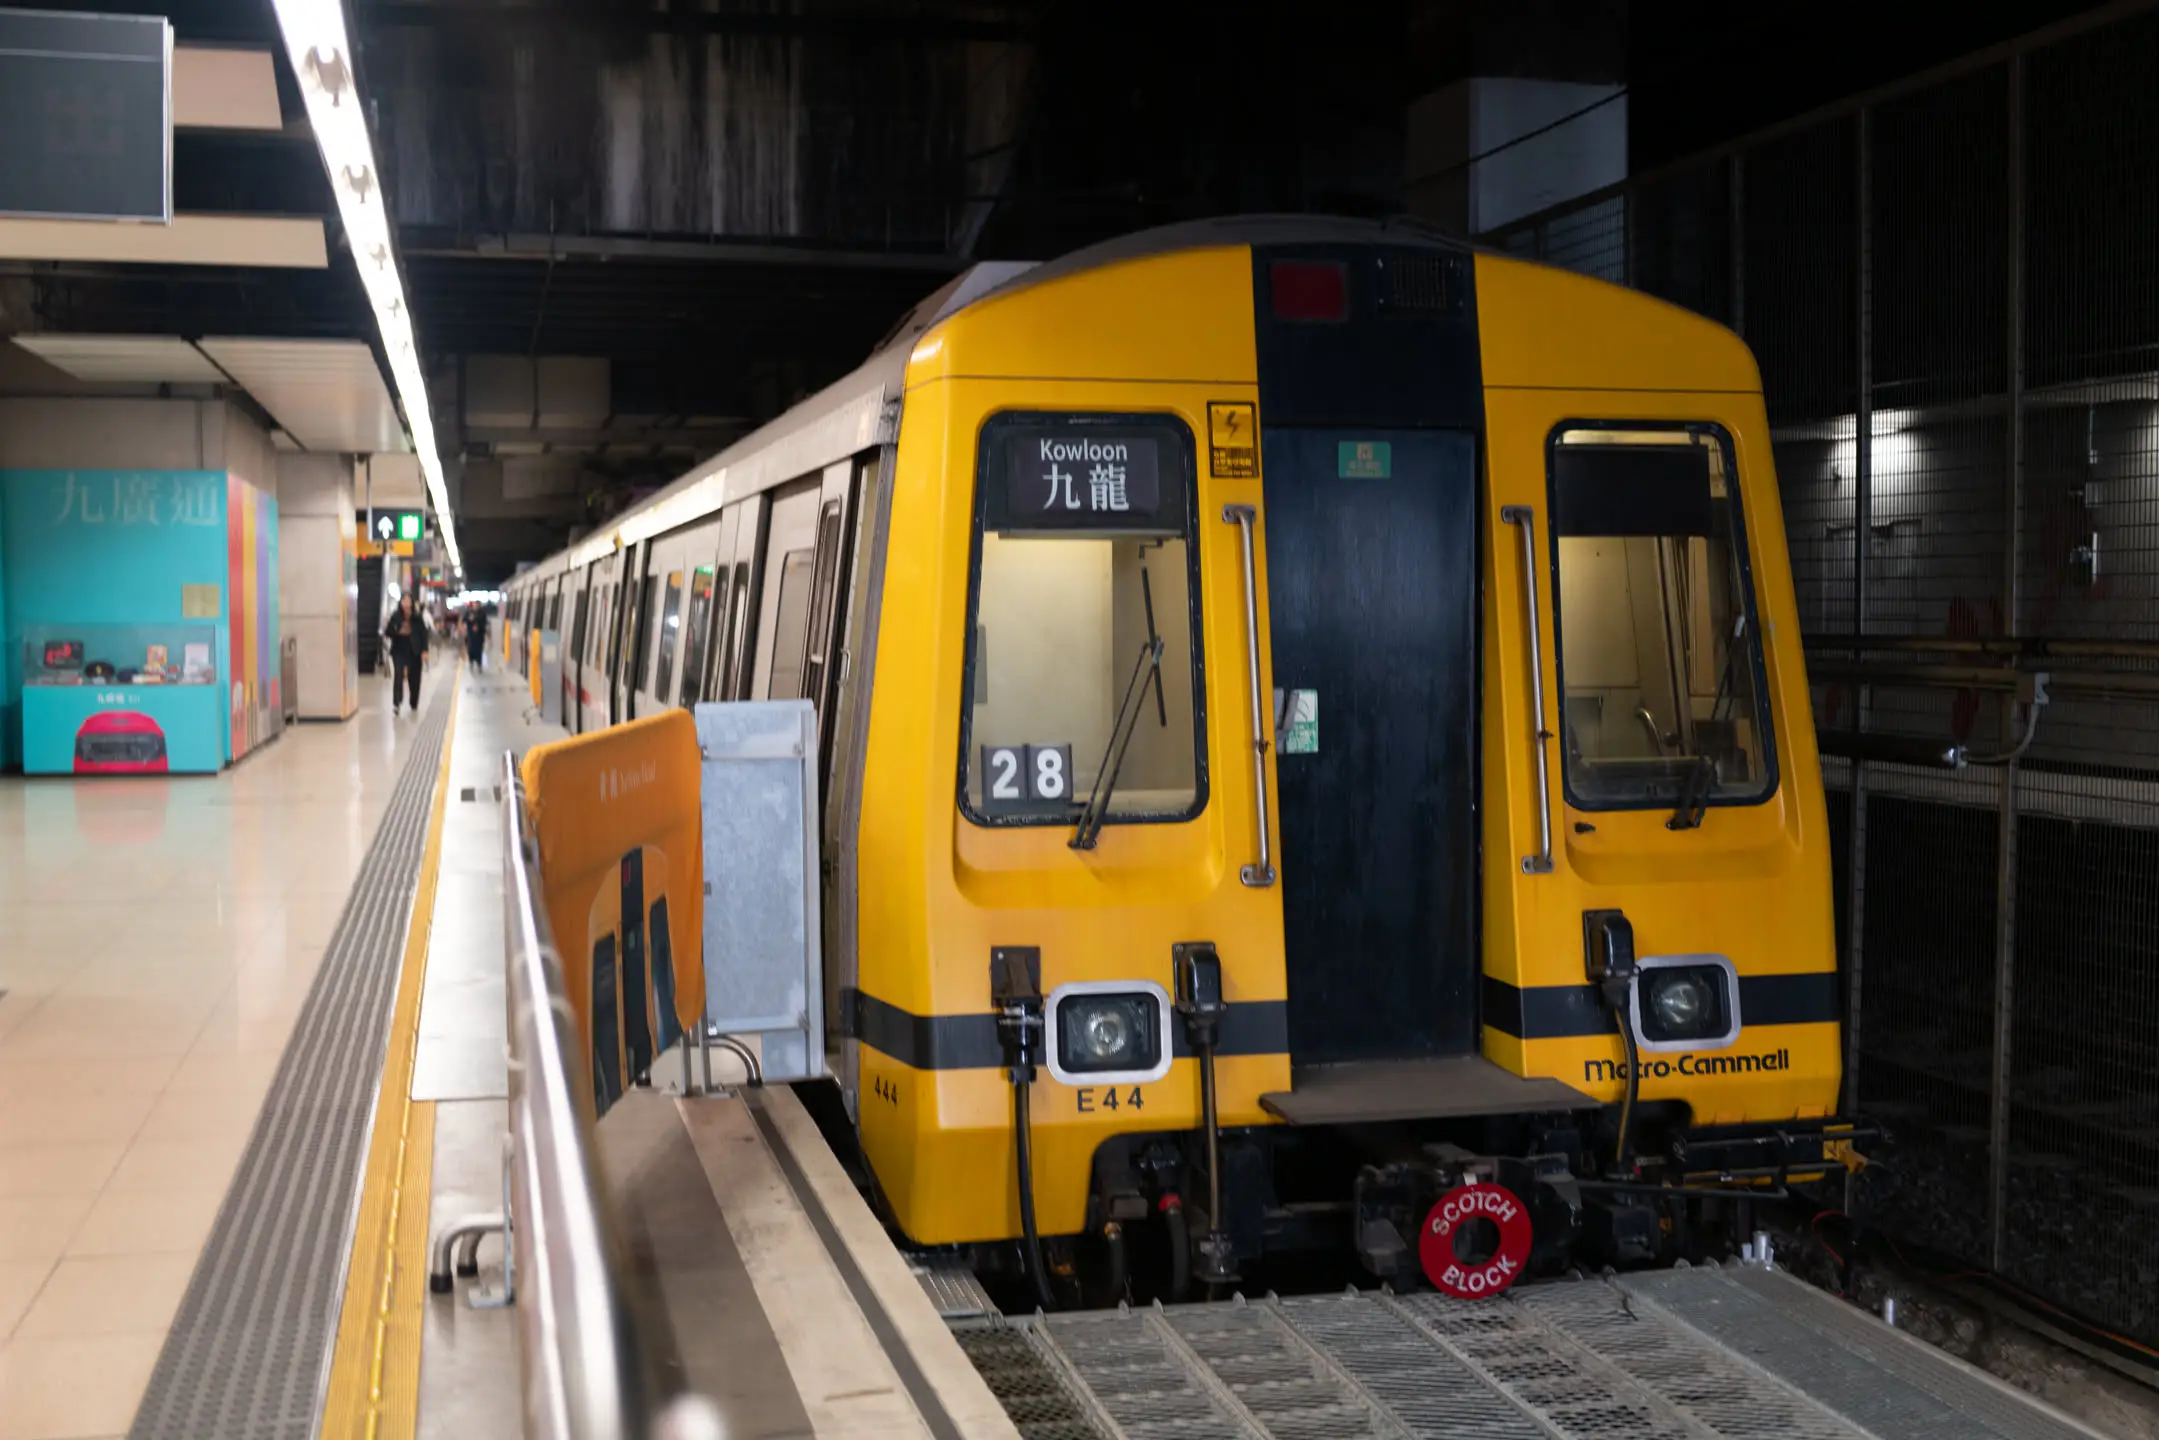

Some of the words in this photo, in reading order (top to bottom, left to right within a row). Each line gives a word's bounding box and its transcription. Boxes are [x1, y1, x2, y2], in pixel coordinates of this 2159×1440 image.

[1040, 438, 1128, 461] Kowloon
[1042, 463, 1130, 511] 九龍
[992, 749, 1064, 799] 28
[874, 1075, 898, 1106] 444
[1077, 1086, 1144, 1112] E44
[1432, 1191, 1517, 1235] SCOTCH
[1442, 1253, 1518, 1292] BLOCK
